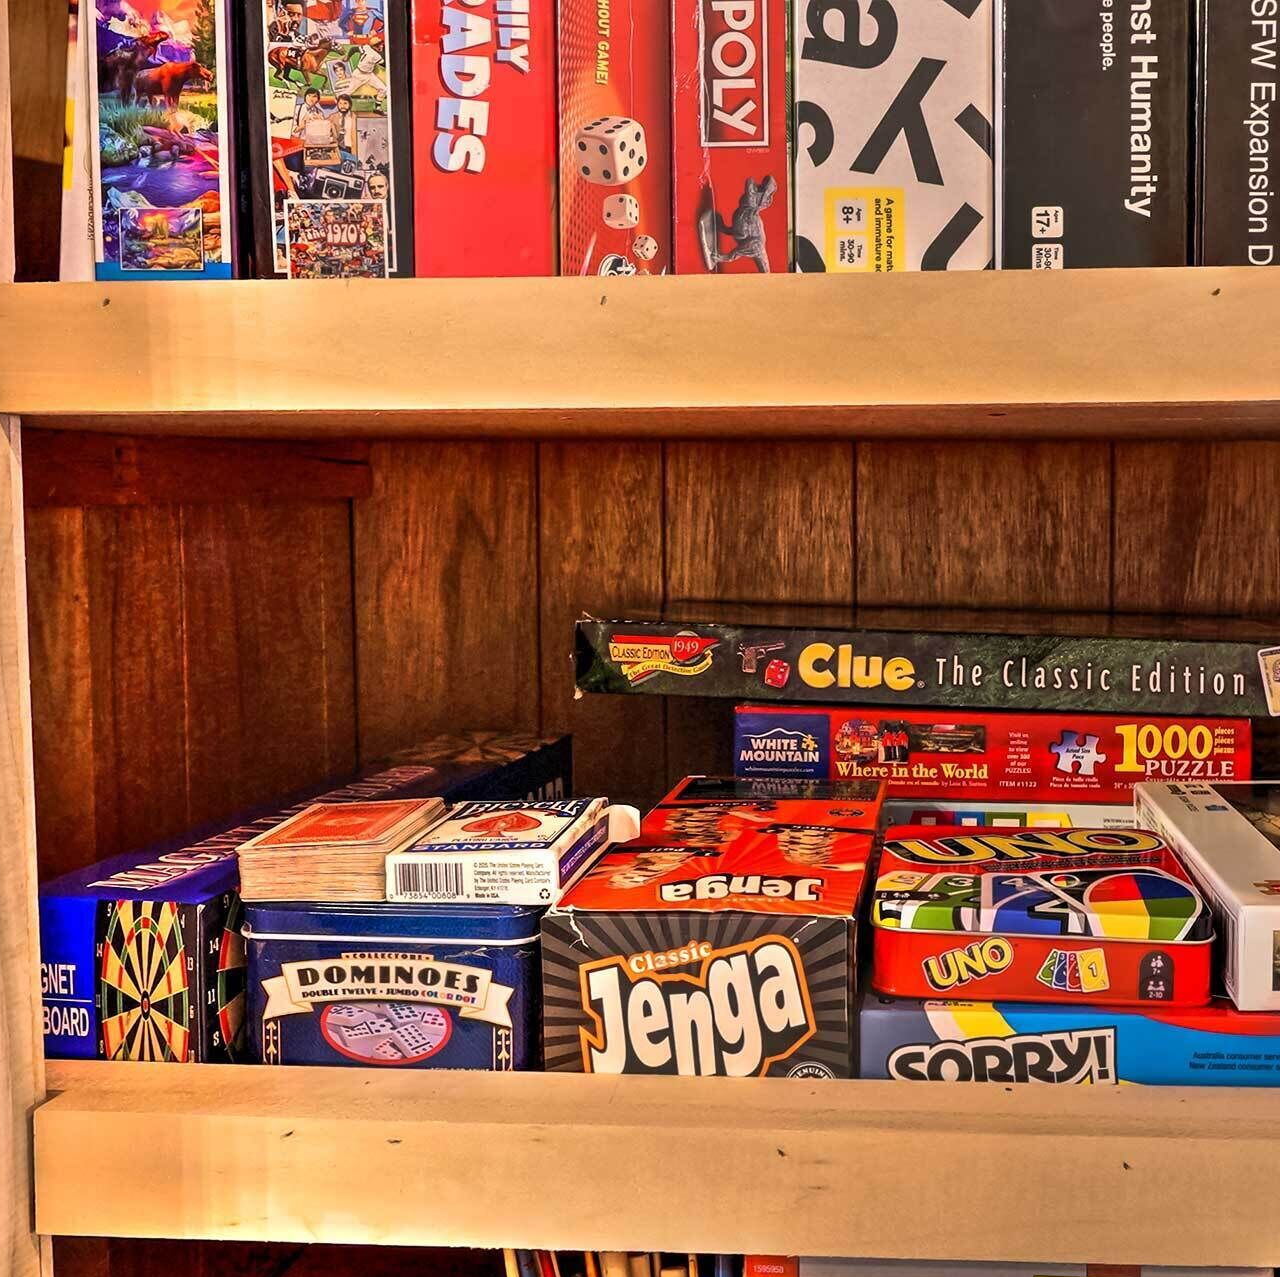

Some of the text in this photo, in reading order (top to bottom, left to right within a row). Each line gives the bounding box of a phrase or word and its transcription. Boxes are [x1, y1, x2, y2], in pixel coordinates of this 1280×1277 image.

[1100, 12, 1116, 72] people.
[595, 41, 611, 86] GAME!
[433, 0, 492, 173] ADES
[1124, 55, 1159, 218] Humanity
[1243, 81, 1276, 234] Expansion
[874, 198, 884, 216] and
[885, 198, 894, 206] A
[841, 206, 854, 224] 8+
[883, 207, 893, 234] game
[1035, 209, 1051, 235] 17+
[304, 223, 367, 244] The 1970's
[874, 217, 884, 262] immature
[885, 236, 895, 249] for
[847, 239, 855, 264] 30-90
[673, 640, 700, 653] 1949
[798, 642, 1246, 696] Clue The Classic Edition
[1214, 726, 1235, 736] pieces
[739, 750, 820, 763] MOUNTAIN
[751, 738, 798, 751] WHITE
[1114, 723, 1214, 773] 1000
[835, 761, 989, 780] Where in the World
[1144, 759, 1235, 777] PUZZLE
[456, 801, 582, 819] BICYCLE
[412, 841, 546, 851] STANDARD
[894, 829, 1163, 862] UNO
[660, 875, 823, 902] Jenga
[629, 943, 711, 975] Classic
[925, 938, 1012, 989] UNO
[1088, 962, 1098, 977] 1
[296, 965, 481, 994] DOMINOES
[301, 987, 477, 1004] DOUBLE TWELVE JUMBO COLOR DOT
[1148, 991, 1164, 999] 2-10
[589, 944, 807, 1077] Jenga
[894, 1034, 1109, 1084] SORRY!
[793, 1066, 830, 1080] ENUIN
